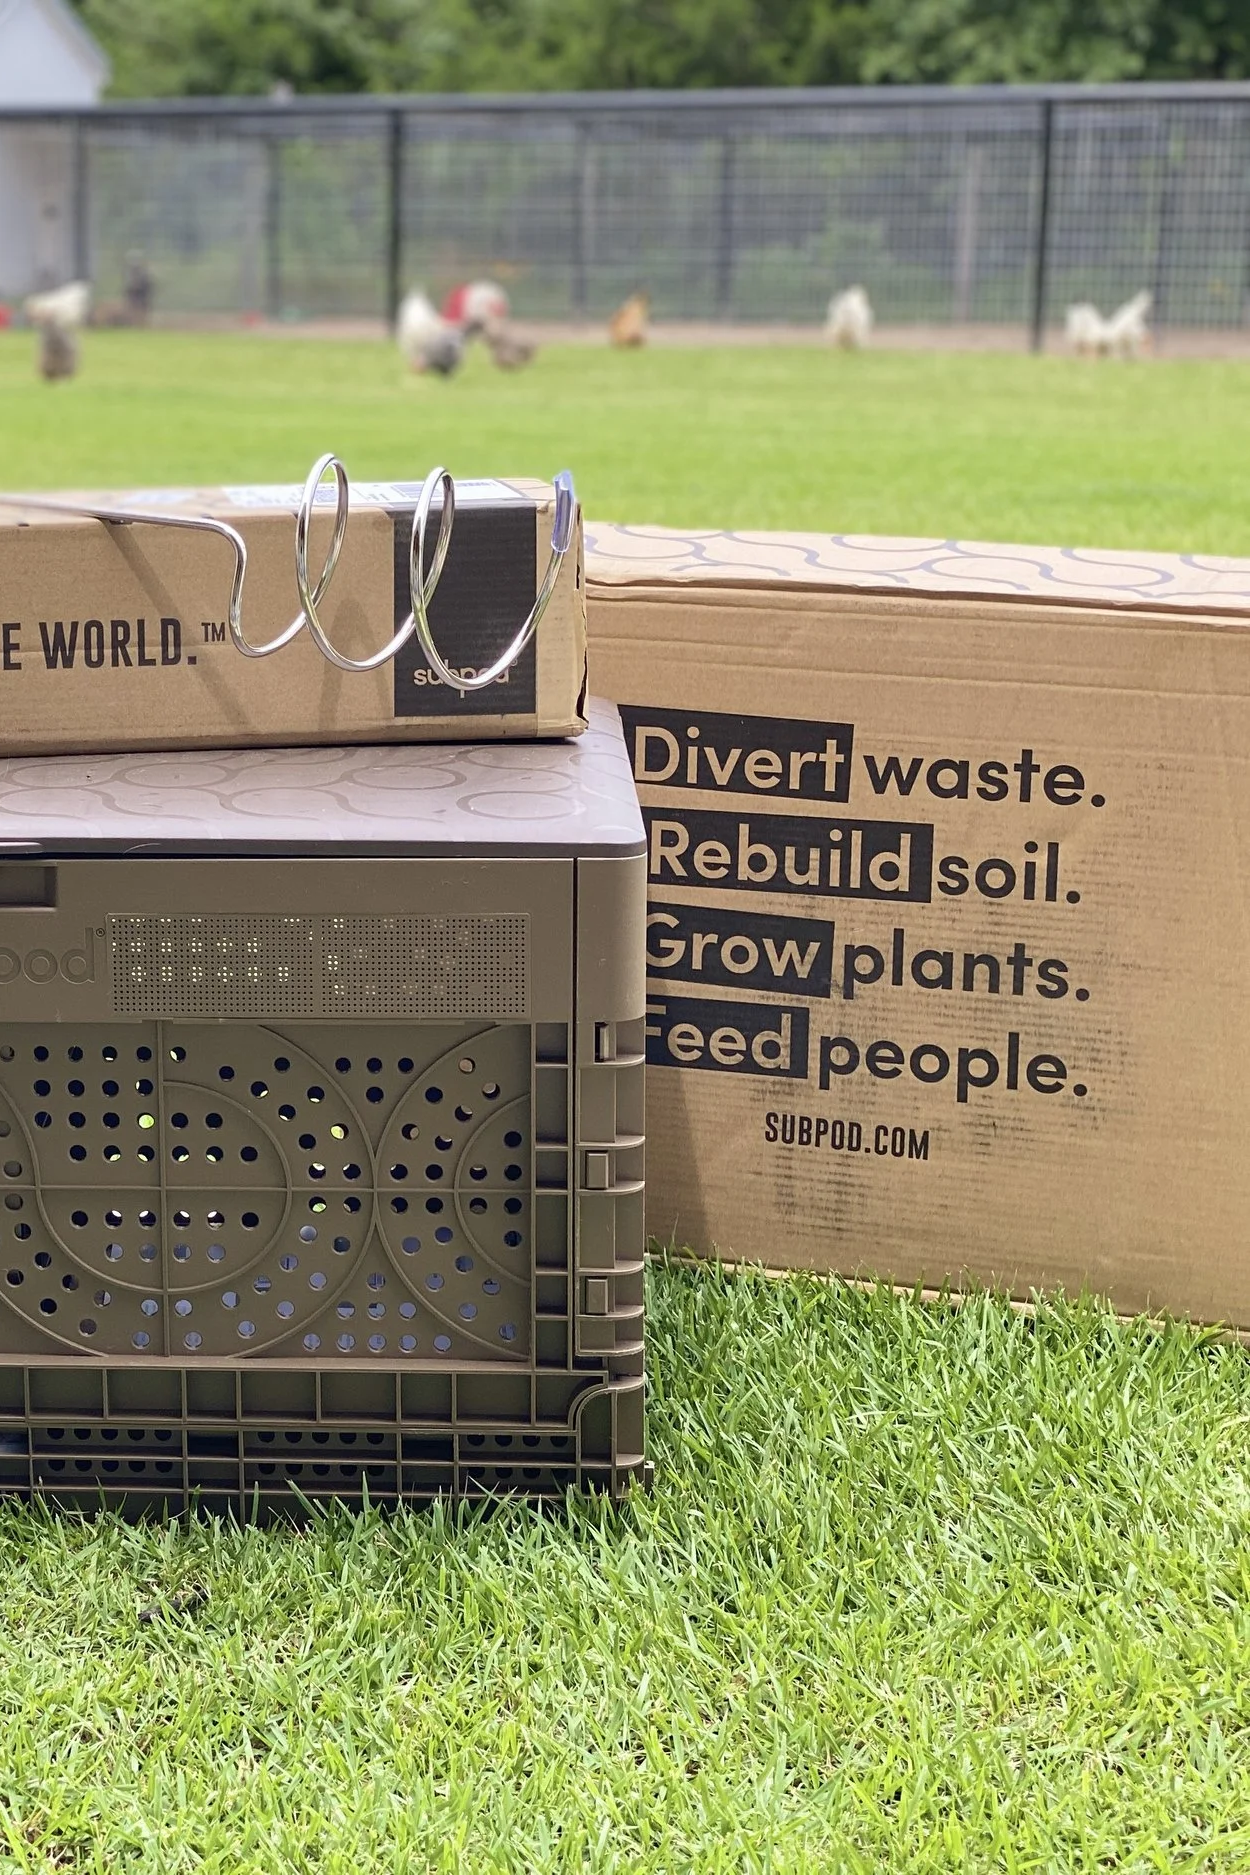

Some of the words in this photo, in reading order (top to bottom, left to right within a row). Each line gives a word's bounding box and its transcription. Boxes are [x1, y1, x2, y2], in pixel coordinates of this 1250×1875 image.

[414, 659, 510, 699] sup
[634, 726, 845, 792] Divert
[863, 749, 1106, 808] waste.
[650, 820, 912, 892] Rebuild
[937, 841, 1081, 904] soil.
[646, 912, 821, 979] Grow
[843, 928, 1090, 1001] plants.
[819, 1032, 1088, 1104] people.
[765, 1112, 930, 1161] SUBPOD.COM
